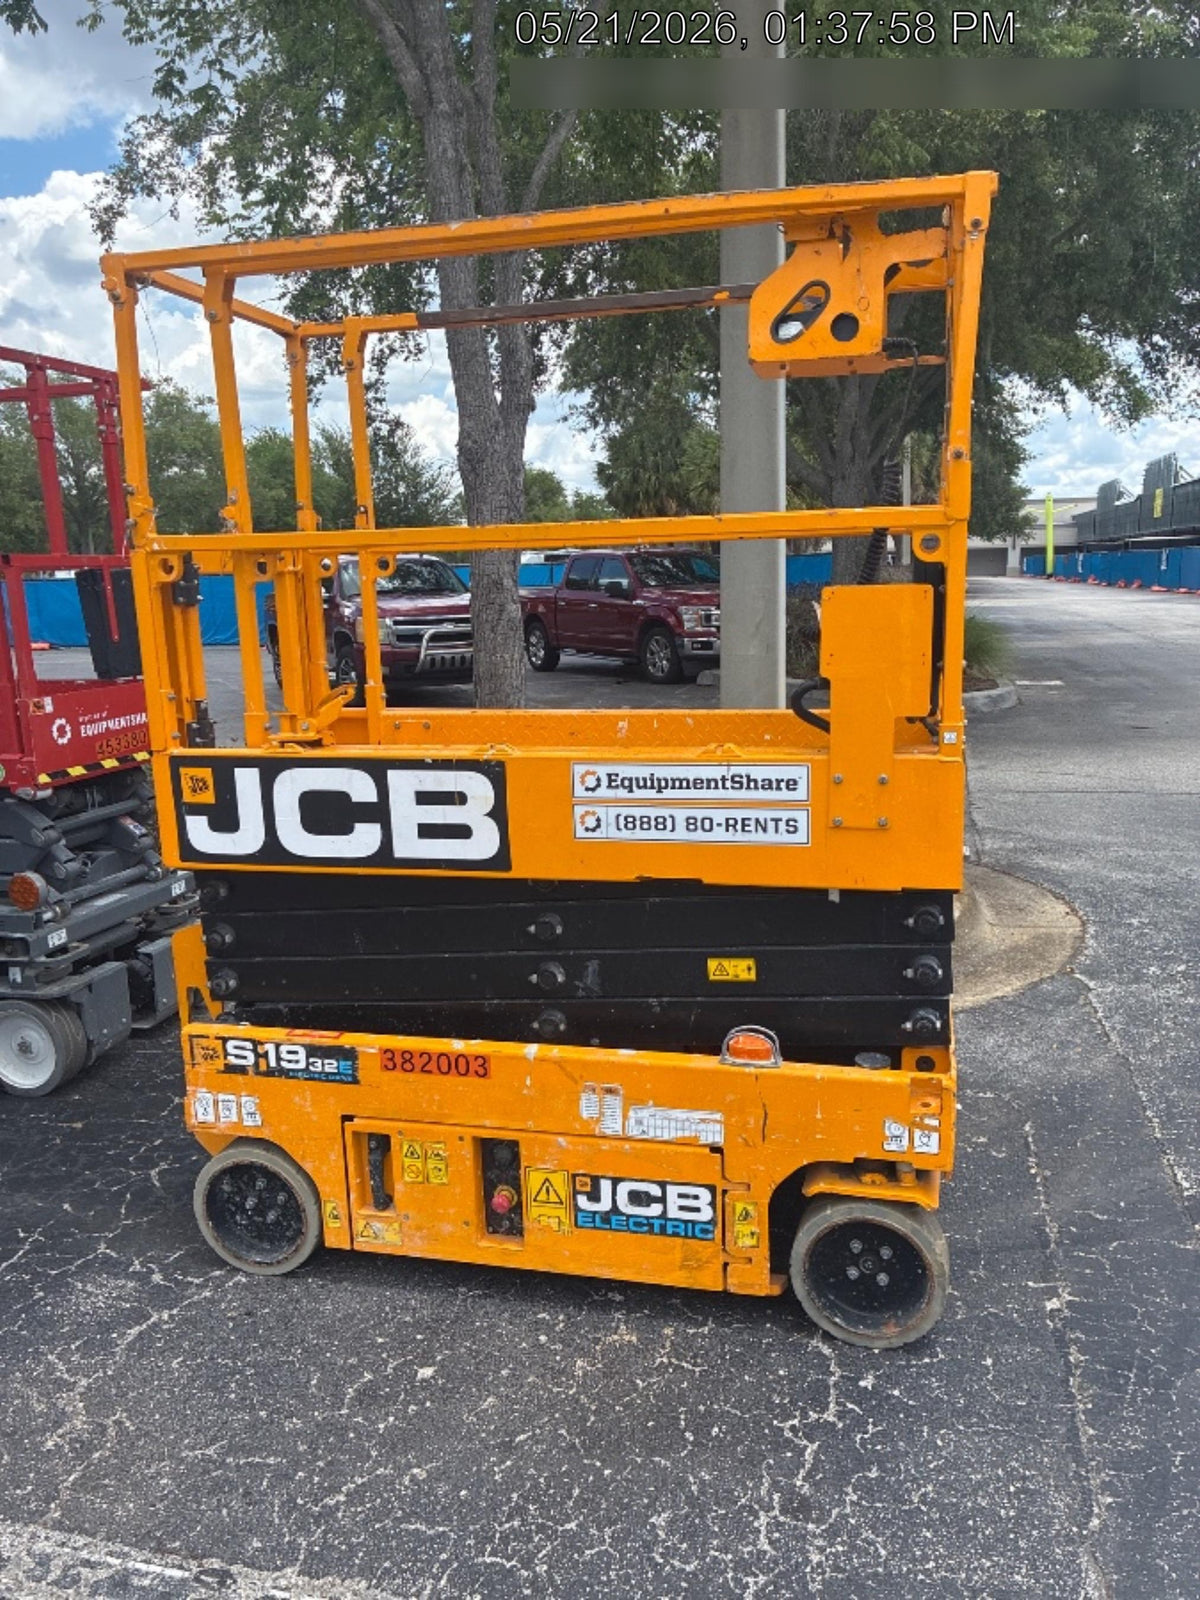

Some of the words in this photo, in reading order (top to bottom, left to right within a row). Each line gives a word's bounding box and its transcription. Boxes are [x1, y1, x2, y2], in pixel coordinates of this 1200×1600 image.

[606, 773, 799, 793] EquipmentShare
[185, 767, 501, 860] JCB
[615, 814, 676, 833] (888)
[685, 816, 799, 834] 80-RENTS
[383, 1048, 488, 1078] 382003
[576, 1178, 714, 1222] JCB
[577, 1211, 715, 1239] ELECTRIC
